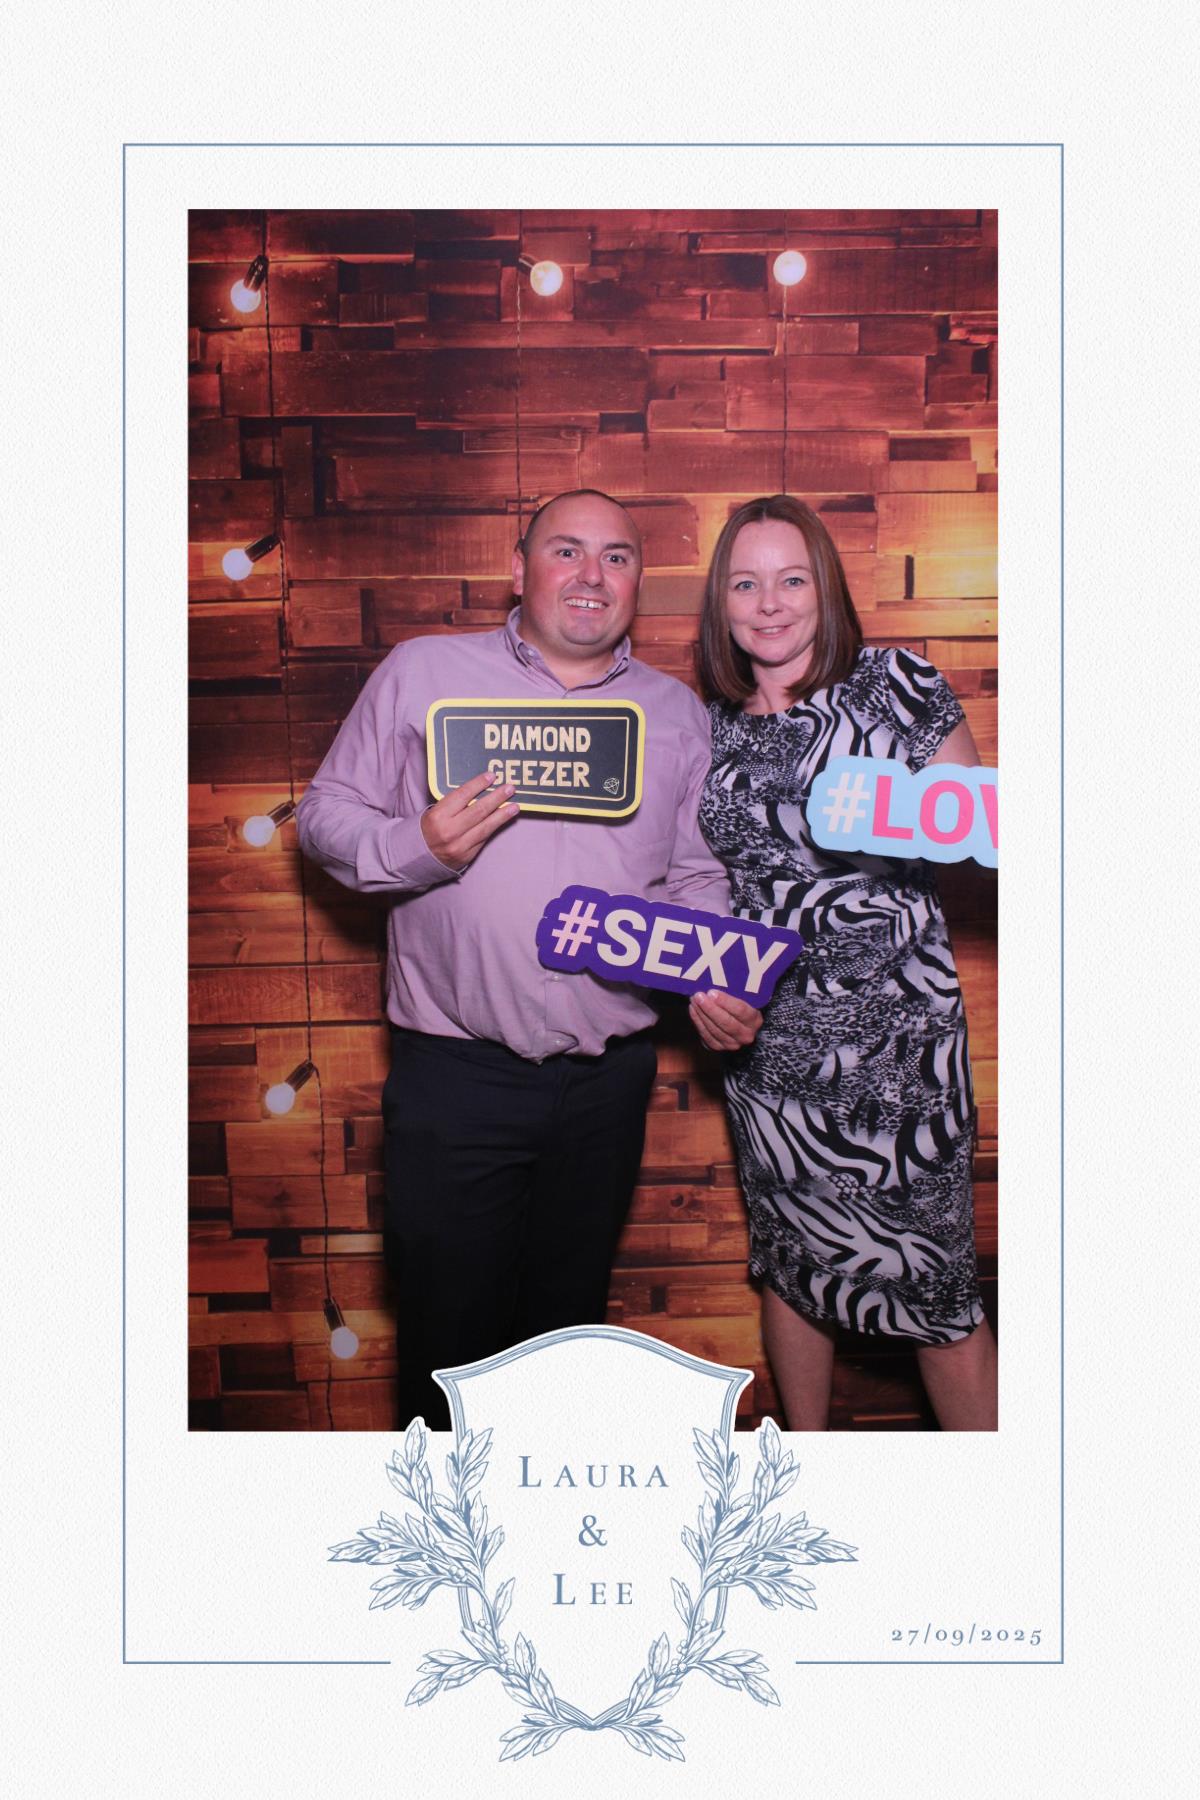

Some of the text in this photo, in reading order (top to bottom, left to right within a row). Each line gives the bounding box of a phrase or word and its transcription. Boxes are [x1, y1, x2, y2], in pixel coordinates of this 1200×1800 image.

[484, 723, 591, 752] DIAMOND
[487, 759, 590, 787] GEEZER
[551, 900, 789, 994] #SEXY
